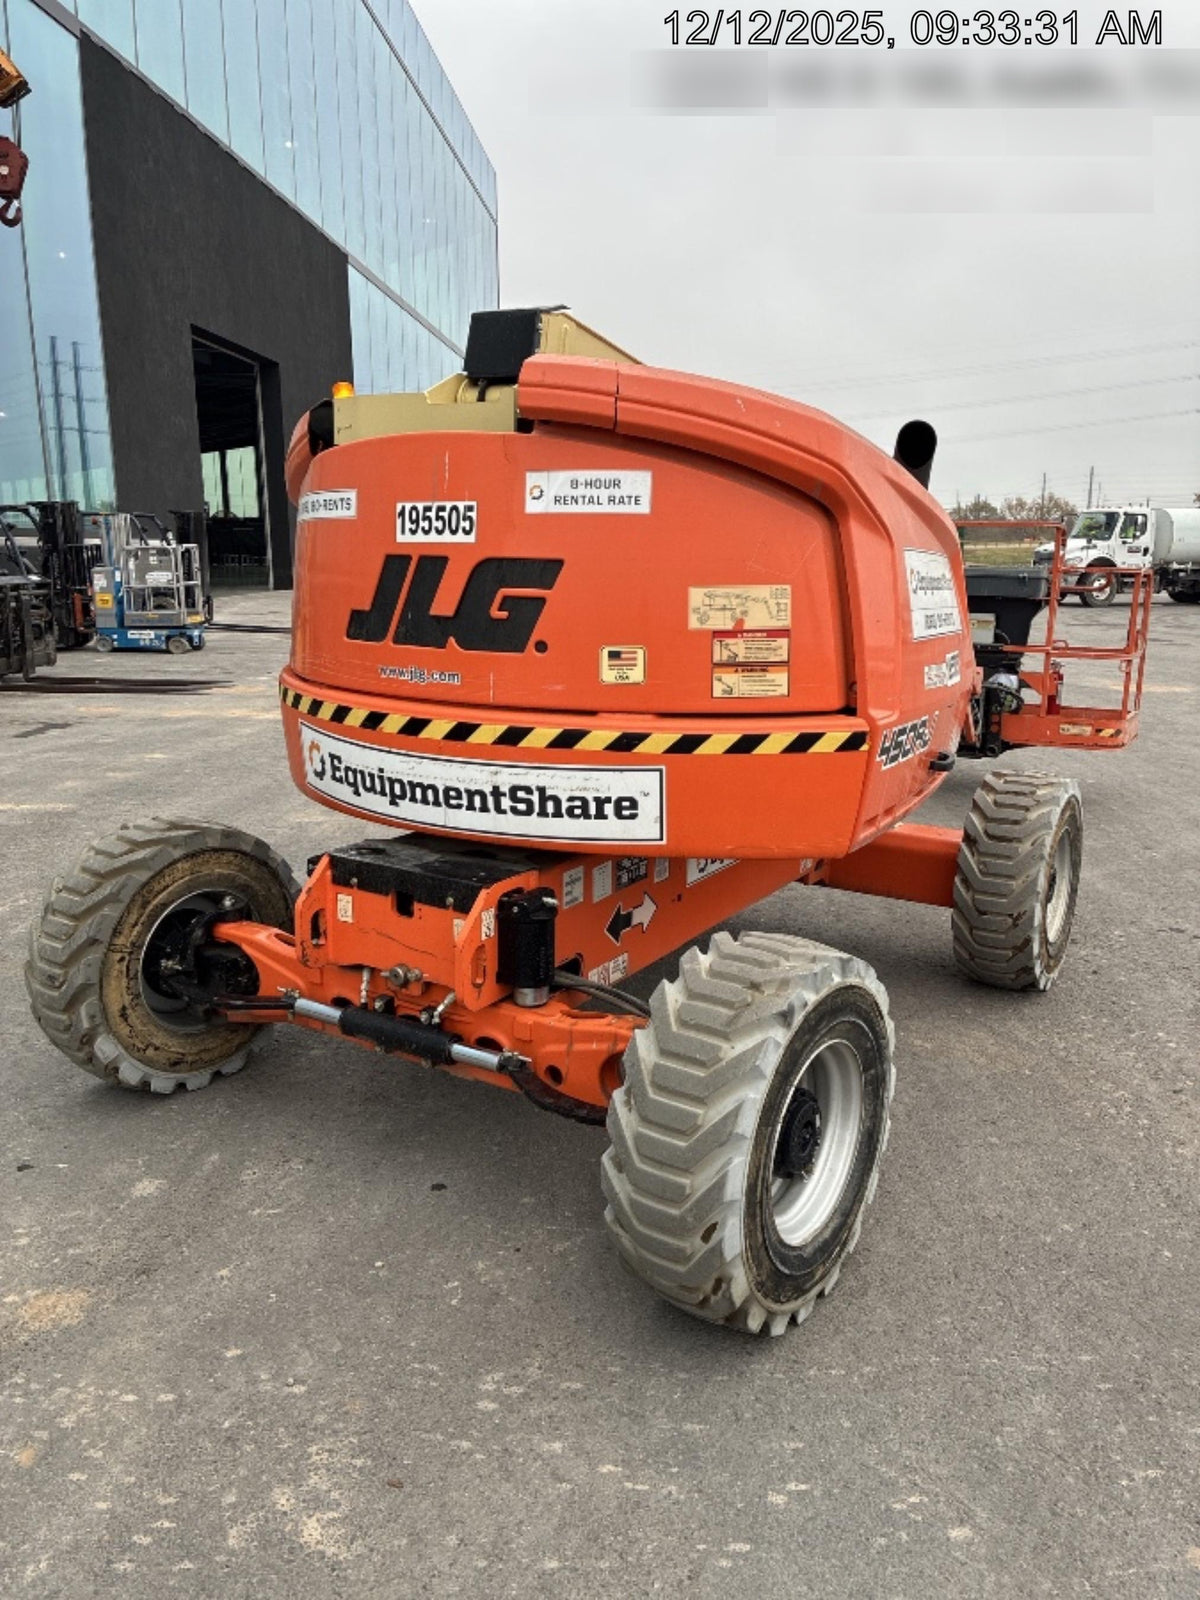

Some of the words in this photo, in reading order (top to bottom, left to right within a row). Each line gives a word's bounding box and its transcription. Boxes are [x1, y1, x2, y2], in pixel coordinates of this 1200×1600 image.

[569, 478, 621, 489] 8-HOUR
[553, 495, 603, 506] RENTAL
[607, 495, 642, 506] RATE
[397, 504, 475, 536] 195505
[378, 664, 461, 685] www.jlg.com
[328, 752, 640, 821] EquipmentShare
